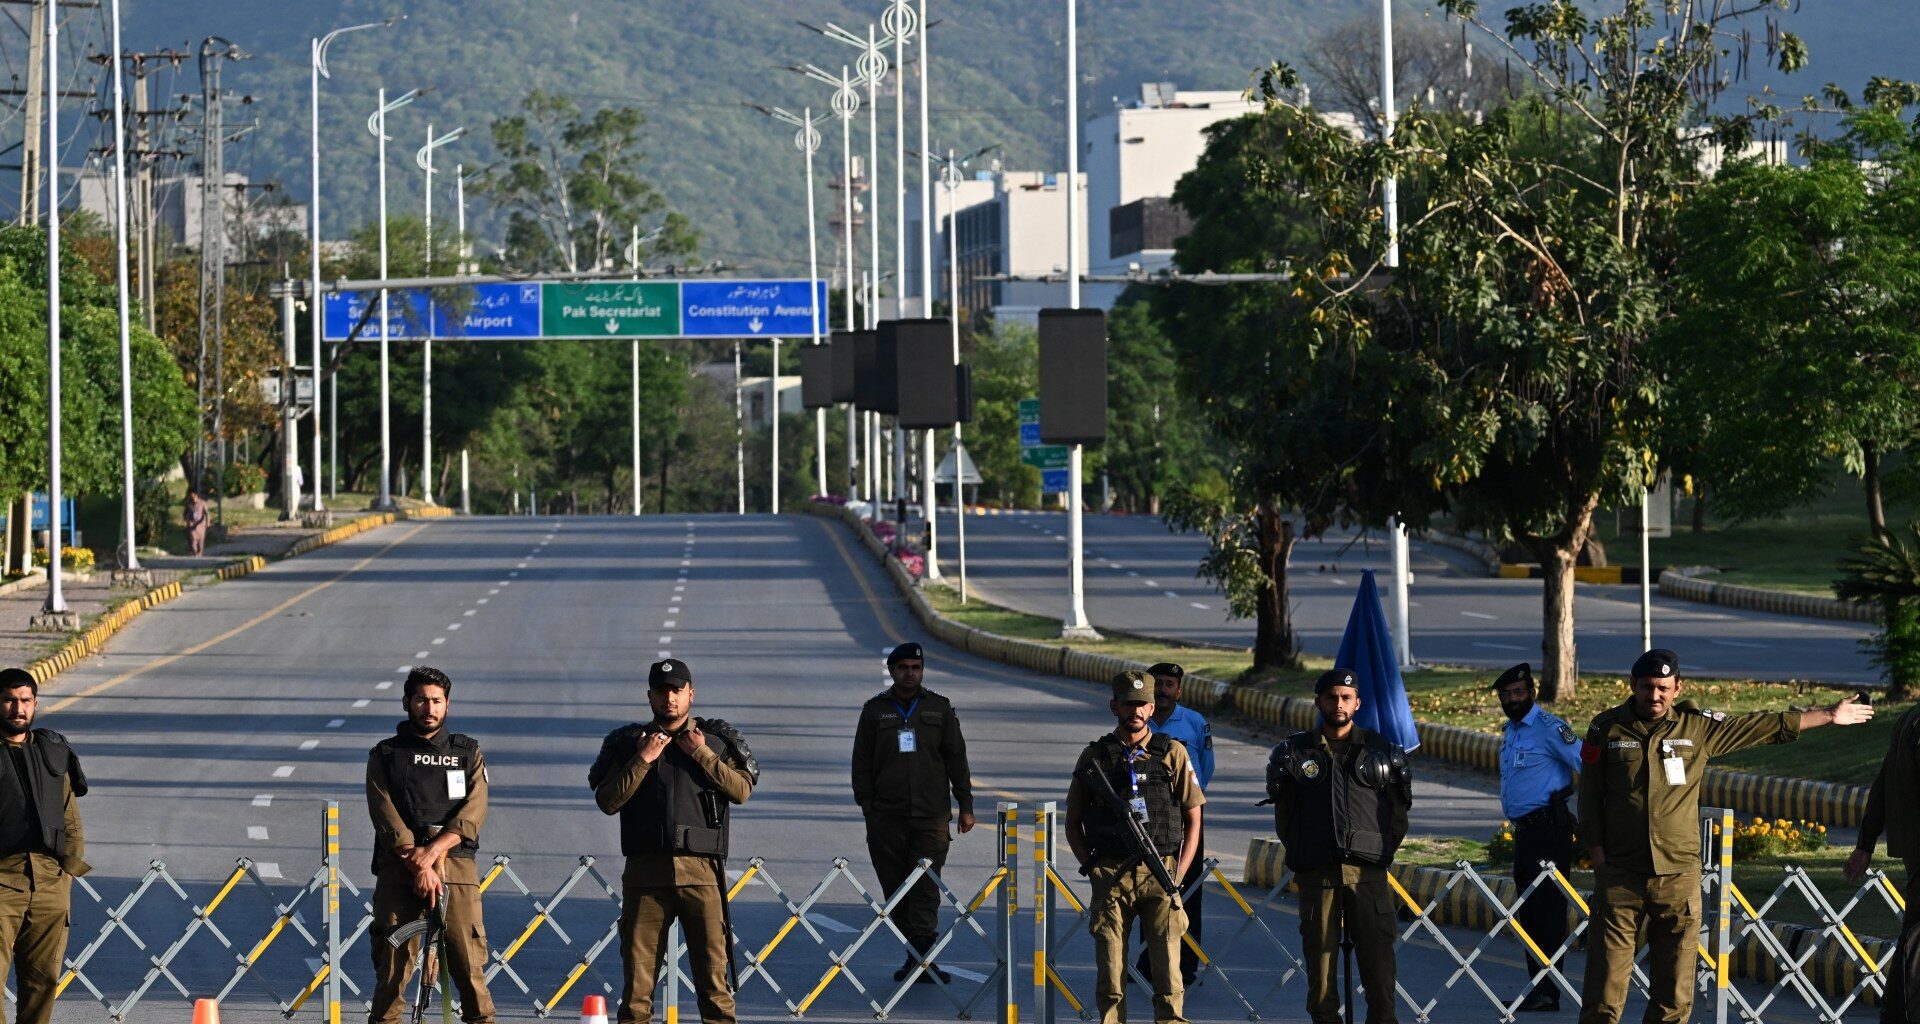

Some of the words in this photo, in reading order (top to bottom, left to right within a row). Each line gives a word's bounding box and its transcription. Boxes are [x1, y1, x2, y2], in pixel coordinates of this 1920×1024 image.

[464, 315, 513, 330] Airport
[562, 305, 587, 318] Pak
[589, 305, 661, 318] Secretariat
[688, 304, 770, 317] Constitution
[774, 304, 819, 317] Avenu
[414, 754, 459, 767] POLICE
[329, 866, 339, 914] ITP
[1007, 870, 1017, 917] ITP
[1034, 877, 1045, 925] ITP
[1719, 884, 1730, 932] ITP
